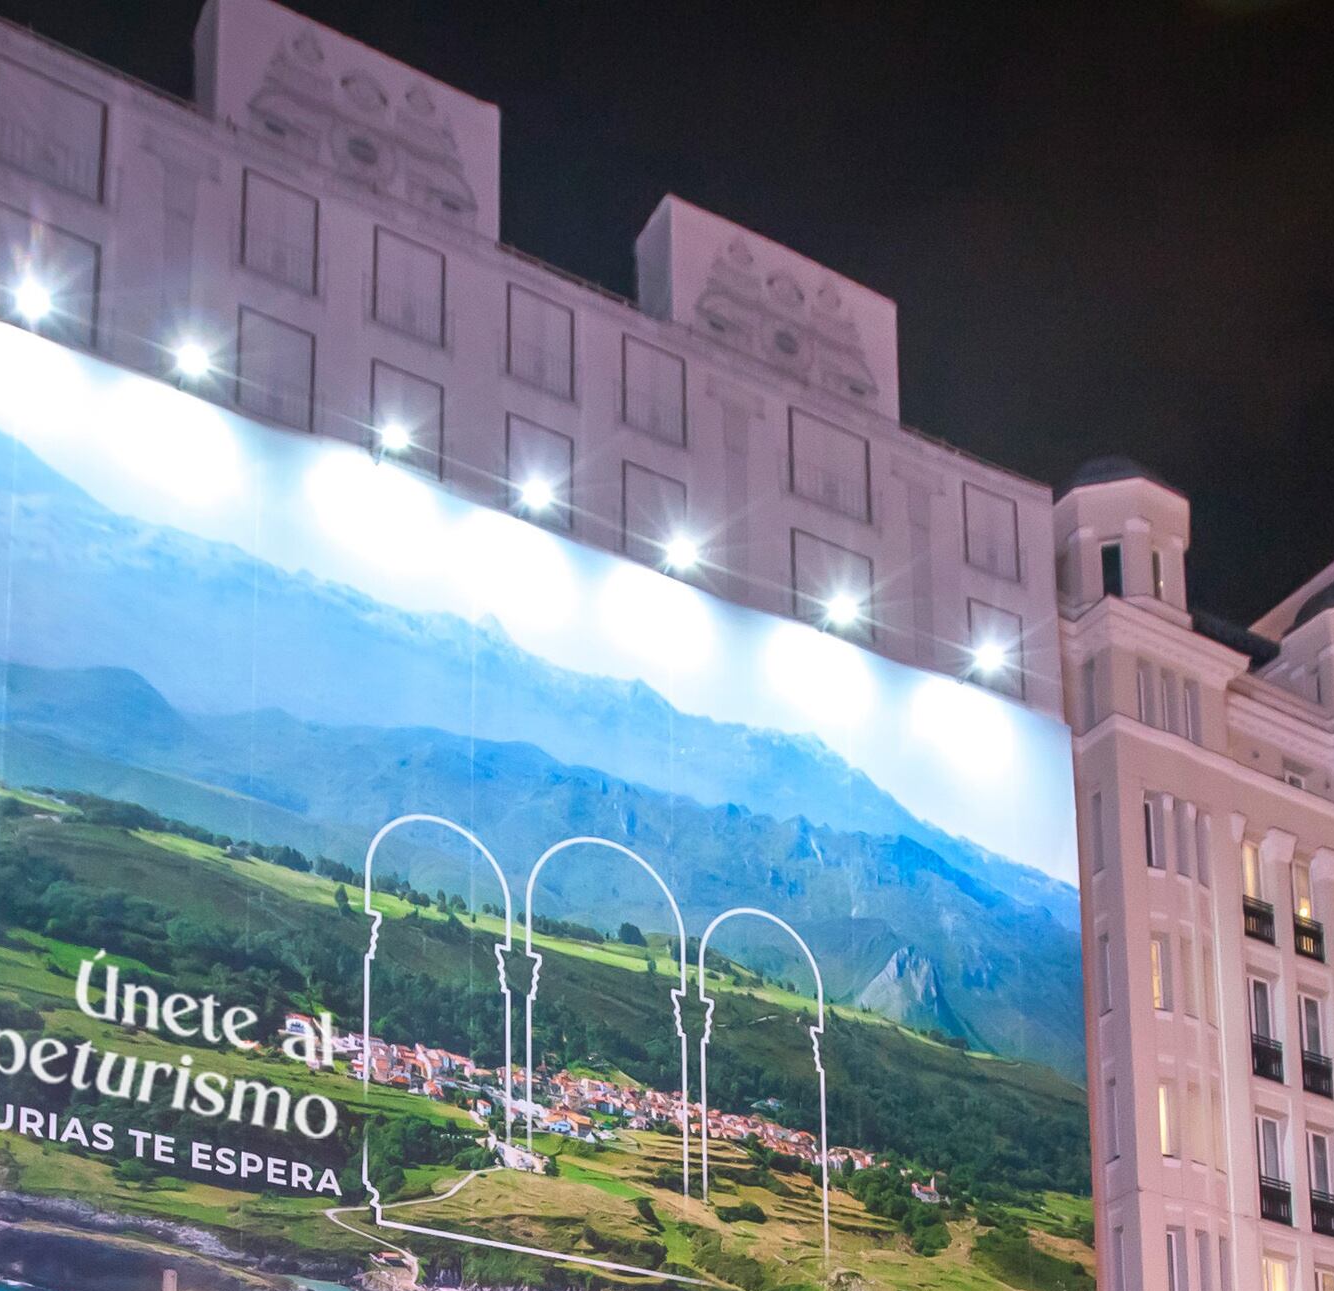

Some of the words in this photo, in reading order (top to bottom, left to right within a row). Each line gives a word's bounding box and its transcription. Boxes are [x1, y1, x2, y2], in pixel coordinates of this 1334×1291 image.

[75, 948, 259, 1052] Únete
[282, 1011, 335, 1069] al
[128, 1128, 176, 1165] TE
[191, 1142, 343, 1197] ESPERA
